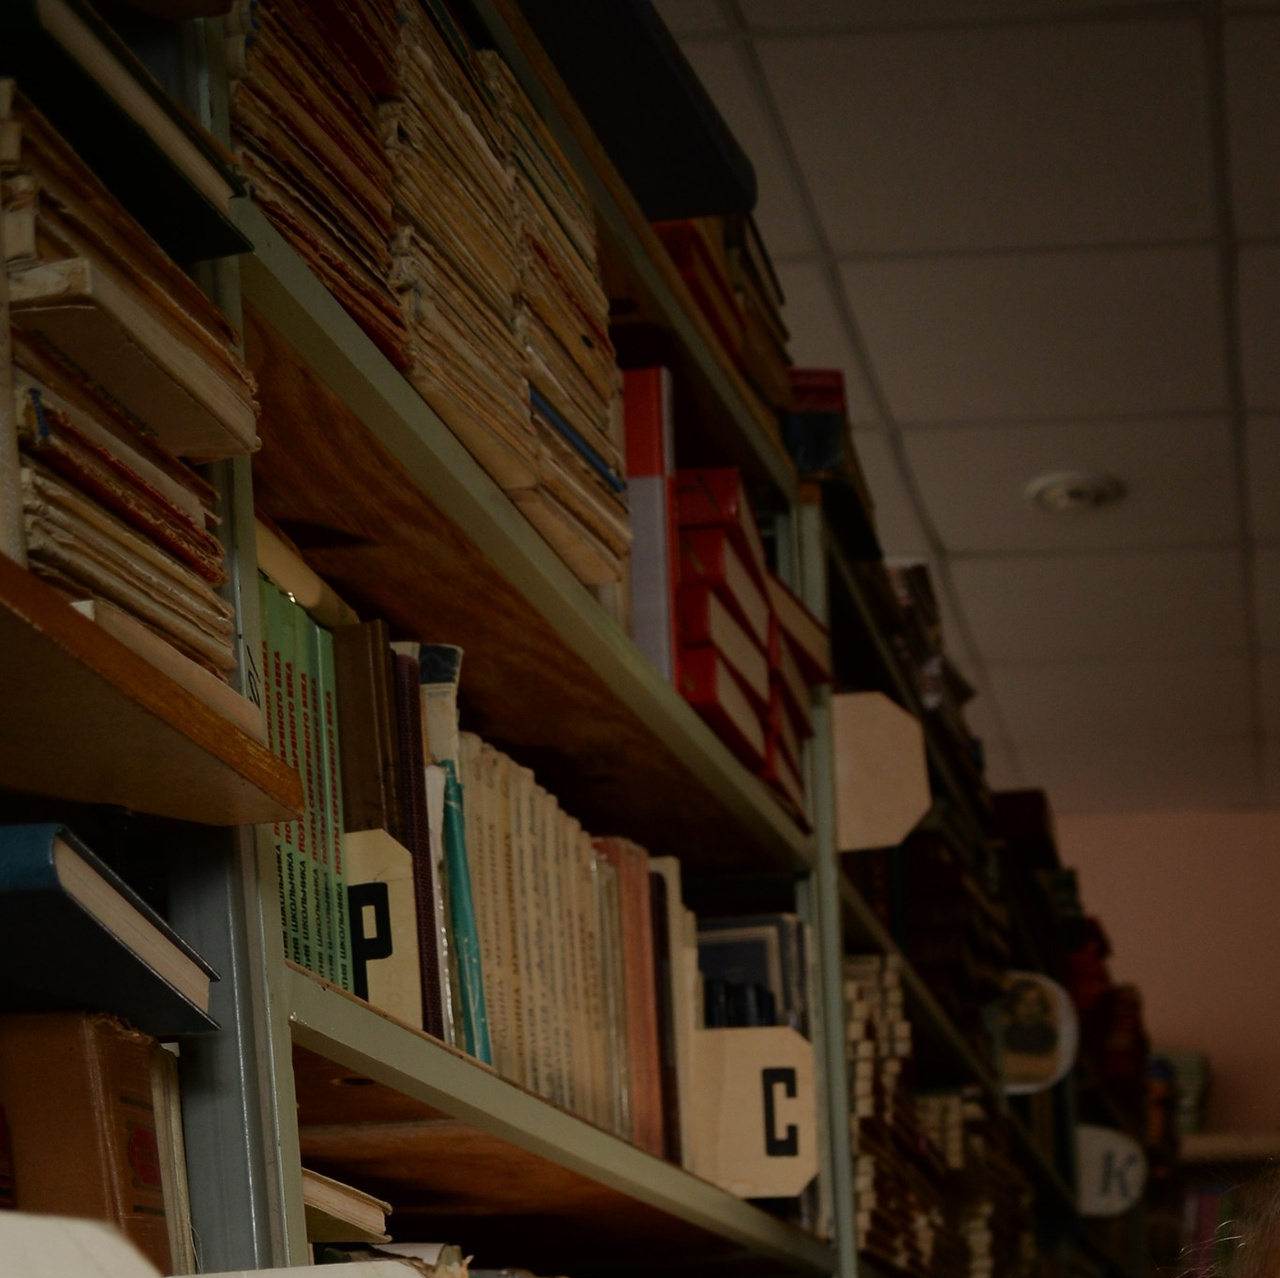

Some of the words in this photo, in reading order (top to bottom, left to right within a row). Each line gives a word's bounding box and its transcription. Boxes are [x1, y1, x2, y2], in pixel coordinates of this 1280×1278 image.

[272, 651, 281, 688] ВЕКА
[285, 662, 293, 698] ВЕКА
[299, 673, 308, 708] ВЕКА
[303, 712, 316, 808] СЕРЕБРЯНОГО
[327, 729, 340, 823] СЕРЕБРЯНОГО
[308, 812, 318, 861] ПОЭТЫ
[332, 827, 342, 875] ПОЭТЫ
[275, 845, 287, 926] ШКОЛЬНИКА
[286, 853, 298, 933] ШКОЛЬНИКА
[298, 860, 310, 940] ШКОЛЬНИКА
[312, 869, 323, 947] ШКОЛЬНИКА
[336, 882, 346, 960] ШКОЛЬНИКА
[350, 882, 391, 1000] Р
[762, 1068, 797, 1157] С
